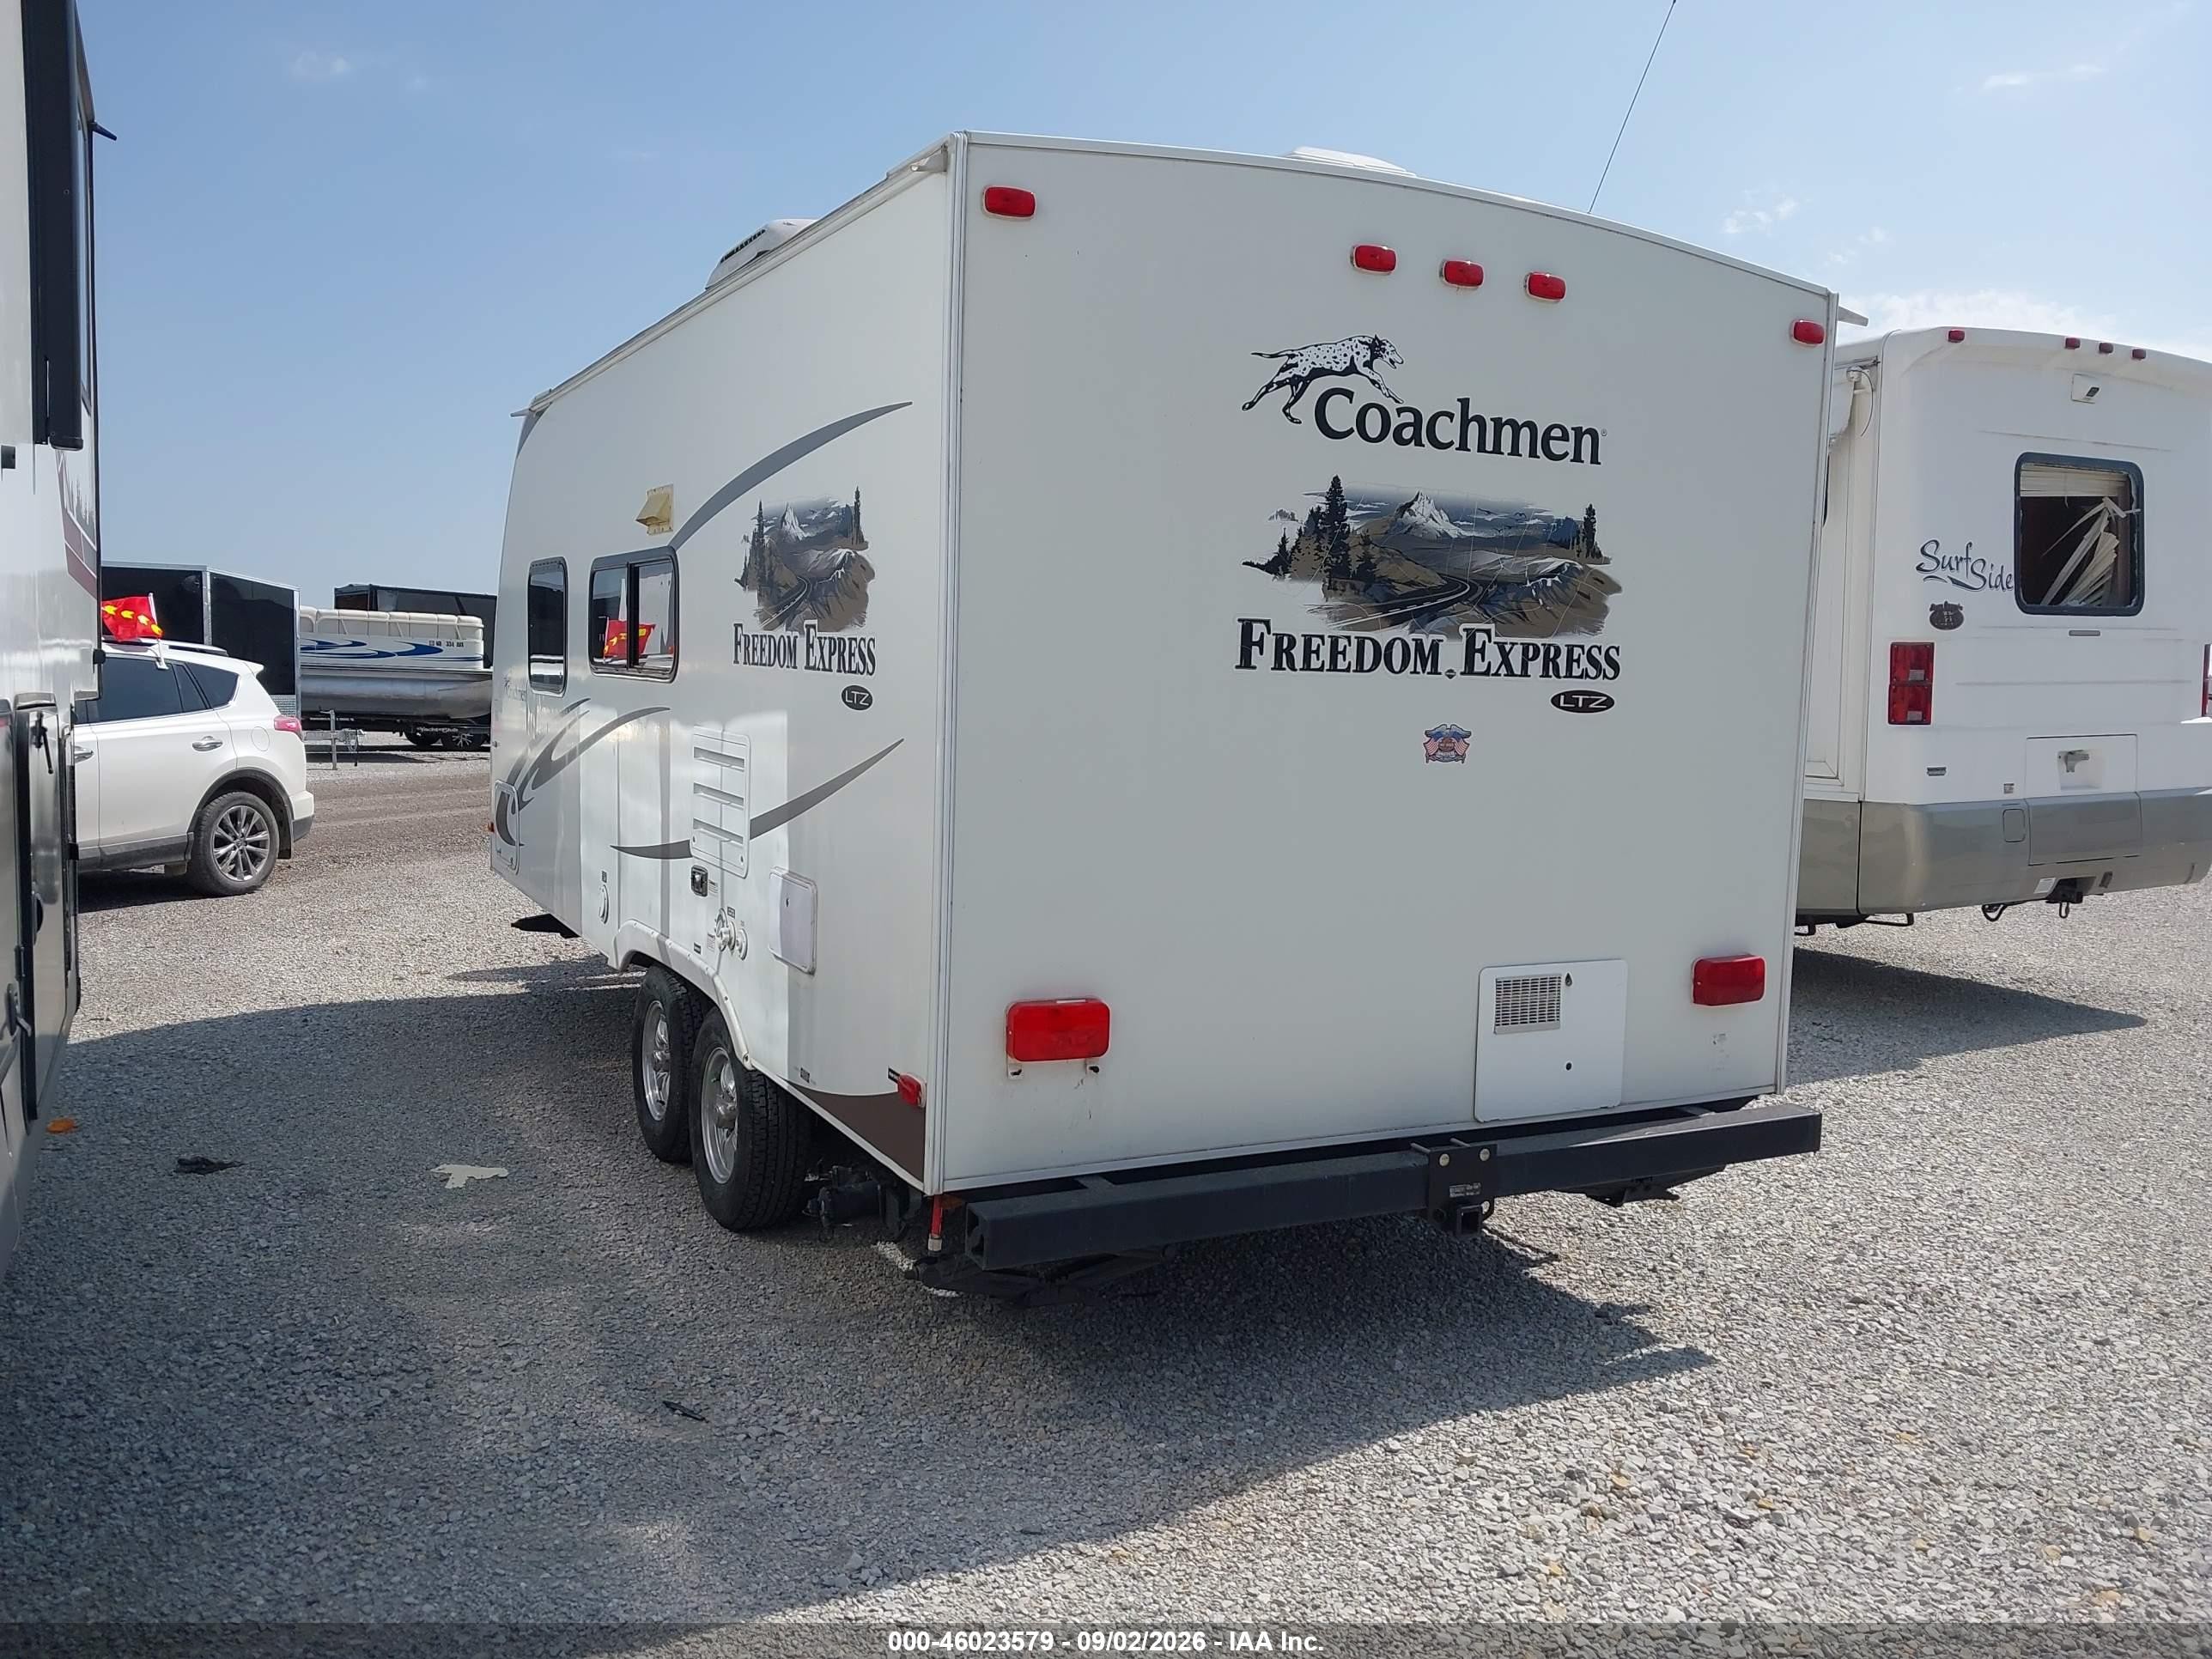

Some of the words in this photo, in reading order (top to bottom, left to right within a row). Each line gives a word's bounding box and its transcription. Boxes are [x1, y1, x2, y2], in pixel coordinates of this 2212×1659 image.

[1315, 387, 1601, 465] Coachmen
[733, 623, 798, 669] FREEDOM
[804, 623, 876, 676] EXPRESS
[1235, 618, 1443, 676] FREEDOM
[1460, 627, 1620, 680] EXPRESS
[845, 690, 870, 706] LTZ
[1559, 695, 1608, 709] LTZ
